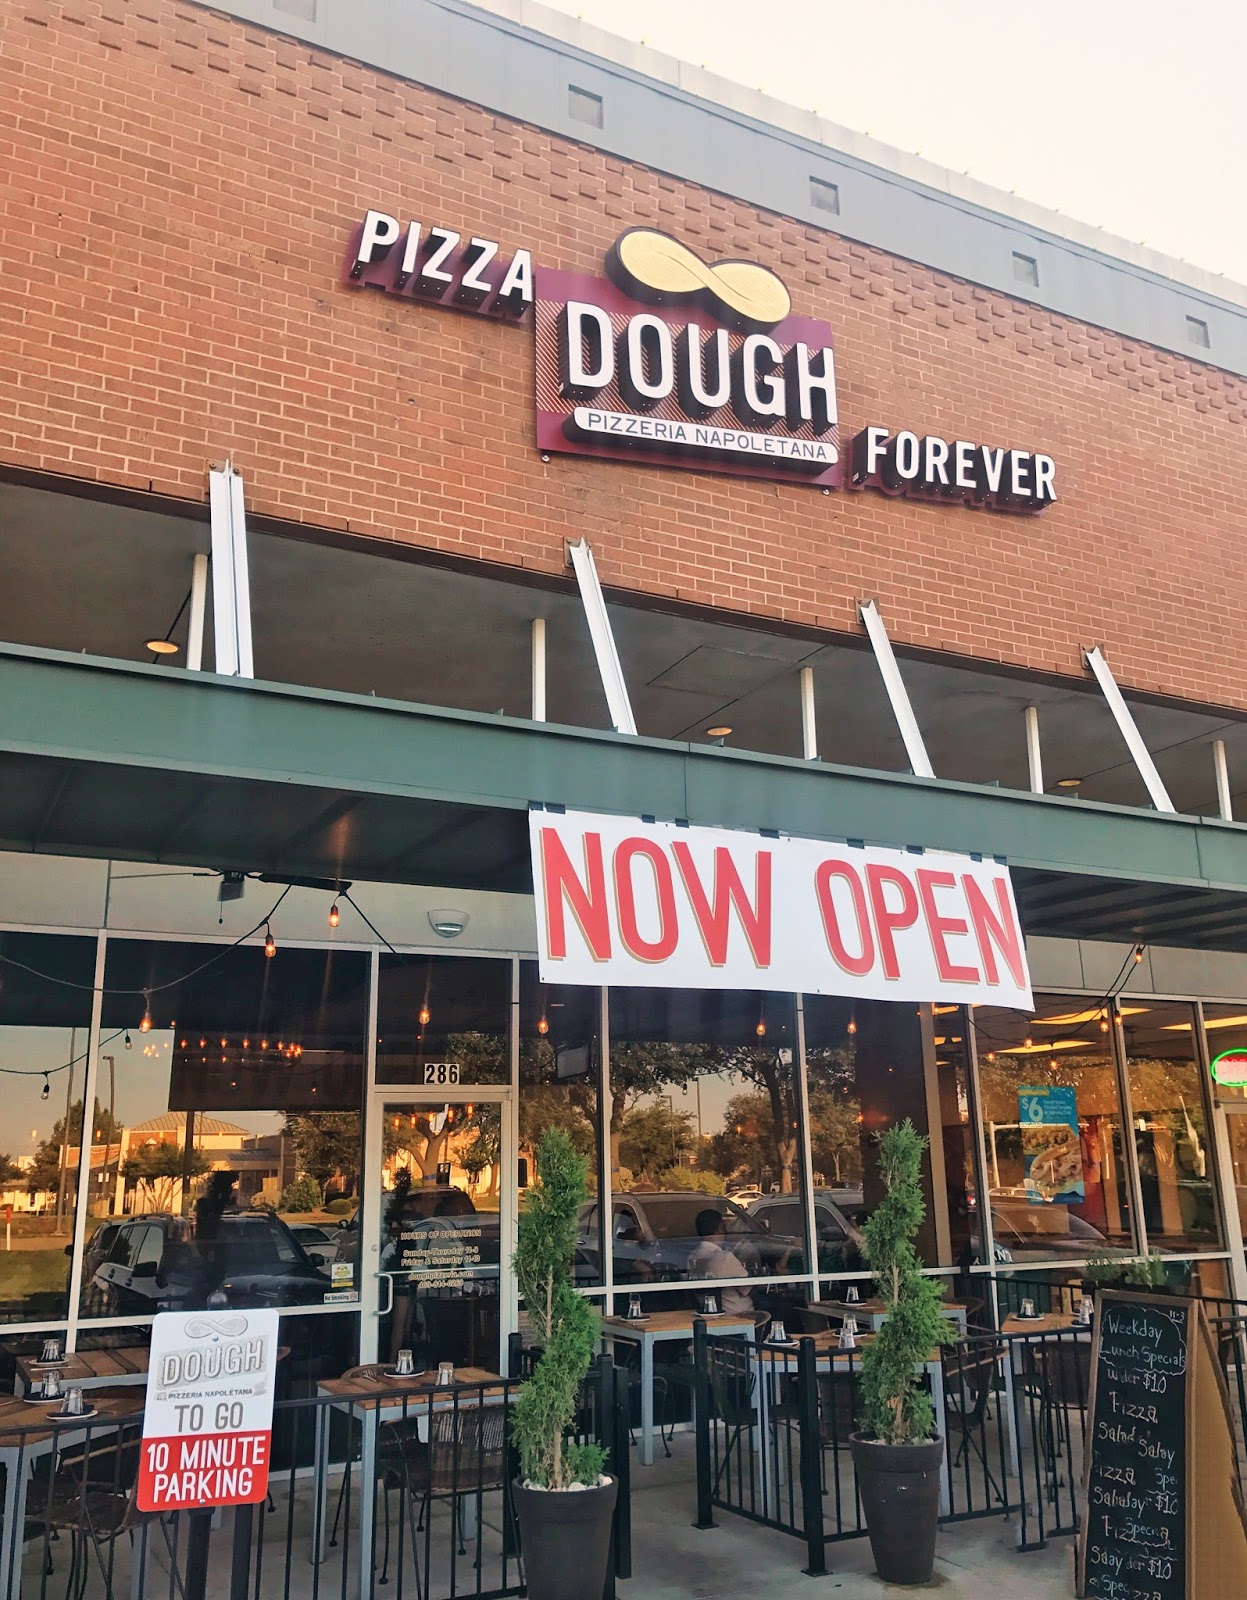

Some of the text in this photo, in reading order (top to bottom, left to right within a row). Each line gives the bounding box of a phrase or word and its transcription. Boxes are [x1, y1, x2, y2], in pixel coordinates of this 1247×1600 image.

[357, 208, 533, 304] PIZZA
[565, 301, 837, 426] DOUGH
[588, 412, 829, 461] PIZZERIA NAPOLETANA
[865, 426, 1057, 502] FOREVER
[539, 826, 1027, 990] NOW OPEN
[424, 1064, 459, 1085] 286
[1021, 1097, 1044, 1122] $6
[400, 1229, 482, 1240] HOURS OF OPERATION
[401, 1257, 424, 1267] Friday
[432, 1256, 463, 1265] Saturday
[331, 1293, 350, 1301] Smoking
[1107, 1314, 1163, 1347] Weekday
[162, 1338, 264, 1387] DOUGH
[1141, 1346, 1186, 1369] Specials
[168, 1388, 253, 1400] PIZZERIA NAPOLETANA
[1143, 1373, 1167, 1394] $10
[174, 1401, 243, 1433] TO GO
[1108, 1391, 1158, 1423] Pizza
[147, 1436, 266, 1473] 10 MINUTE
[153, 1467, 253, 1504] PARKING
[1147, 1559, 1172, 1580] $10
